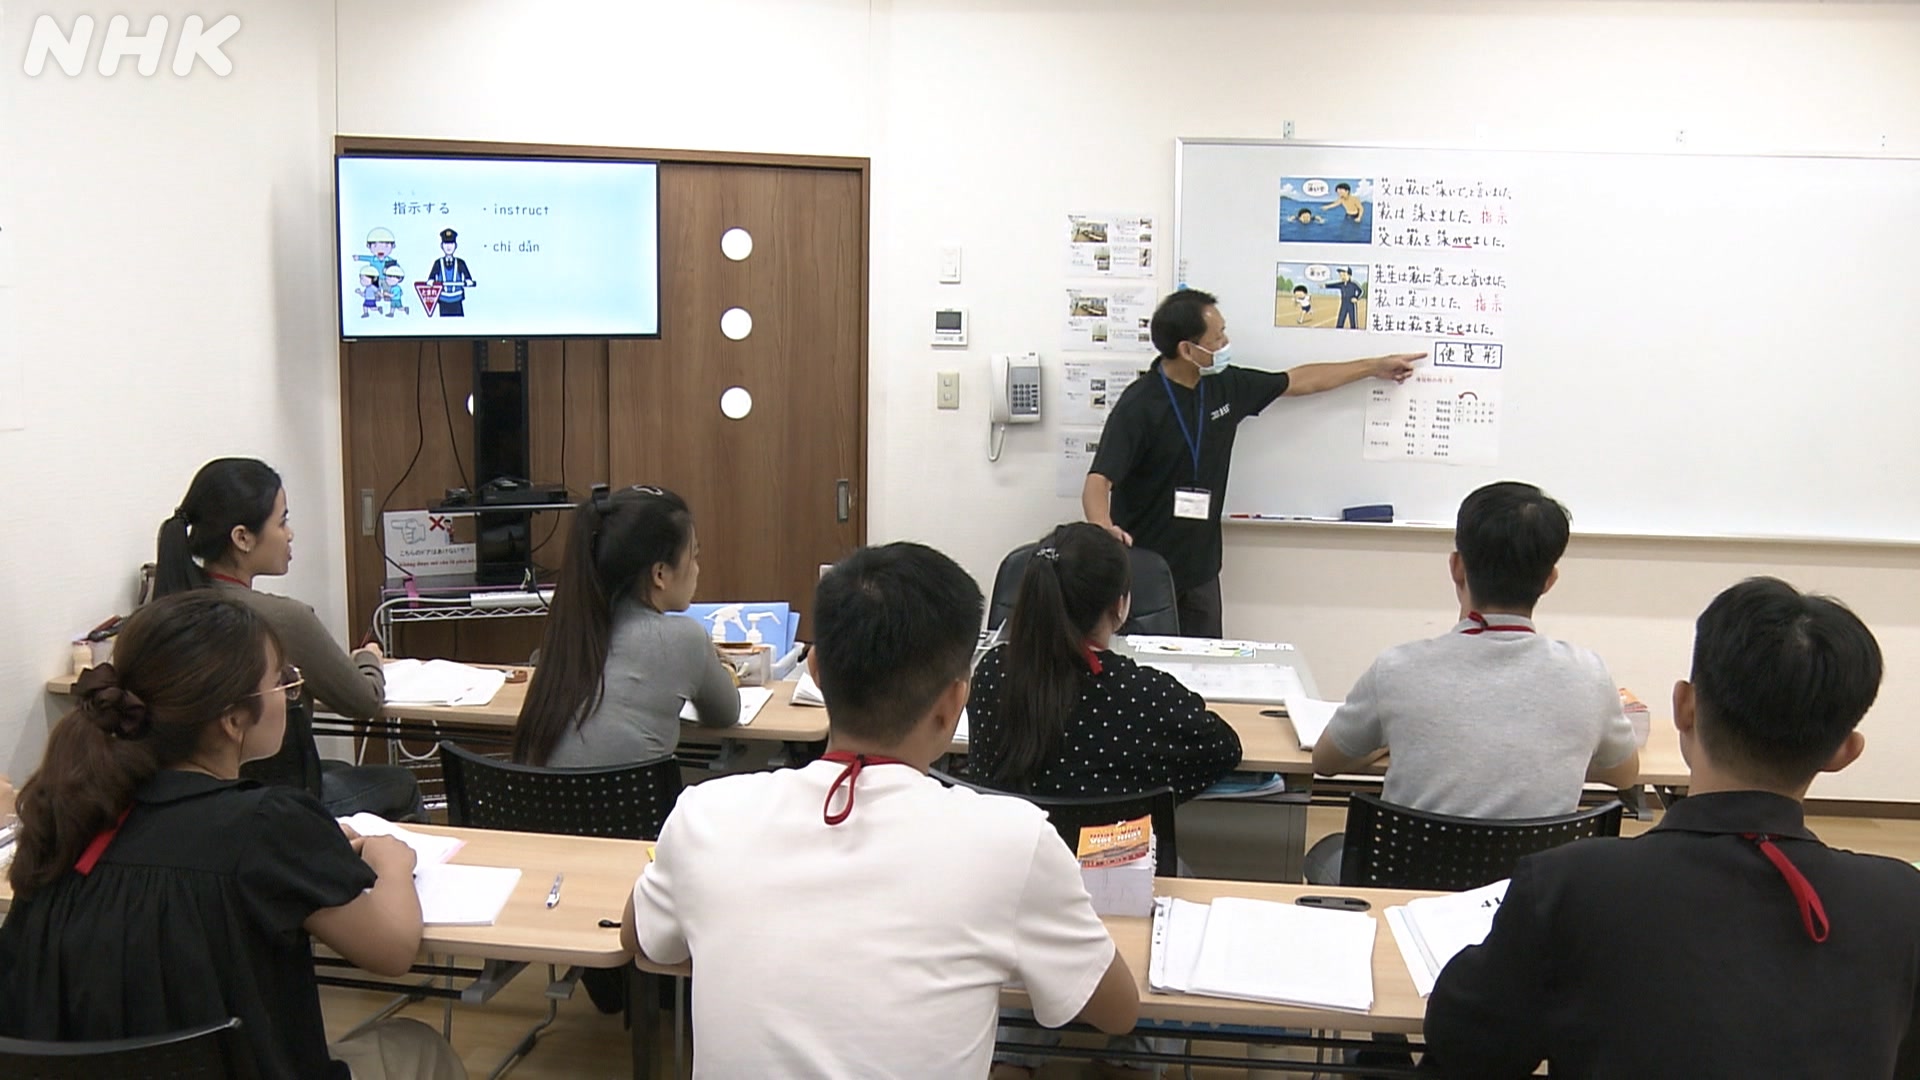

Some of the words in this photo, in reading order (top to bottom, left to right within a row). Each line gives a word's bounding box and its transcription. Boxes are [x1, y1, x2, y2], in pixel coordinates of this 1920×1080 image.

[393, 201, 451, 216] 指示する
[494, 203, 550, 216] instruct
